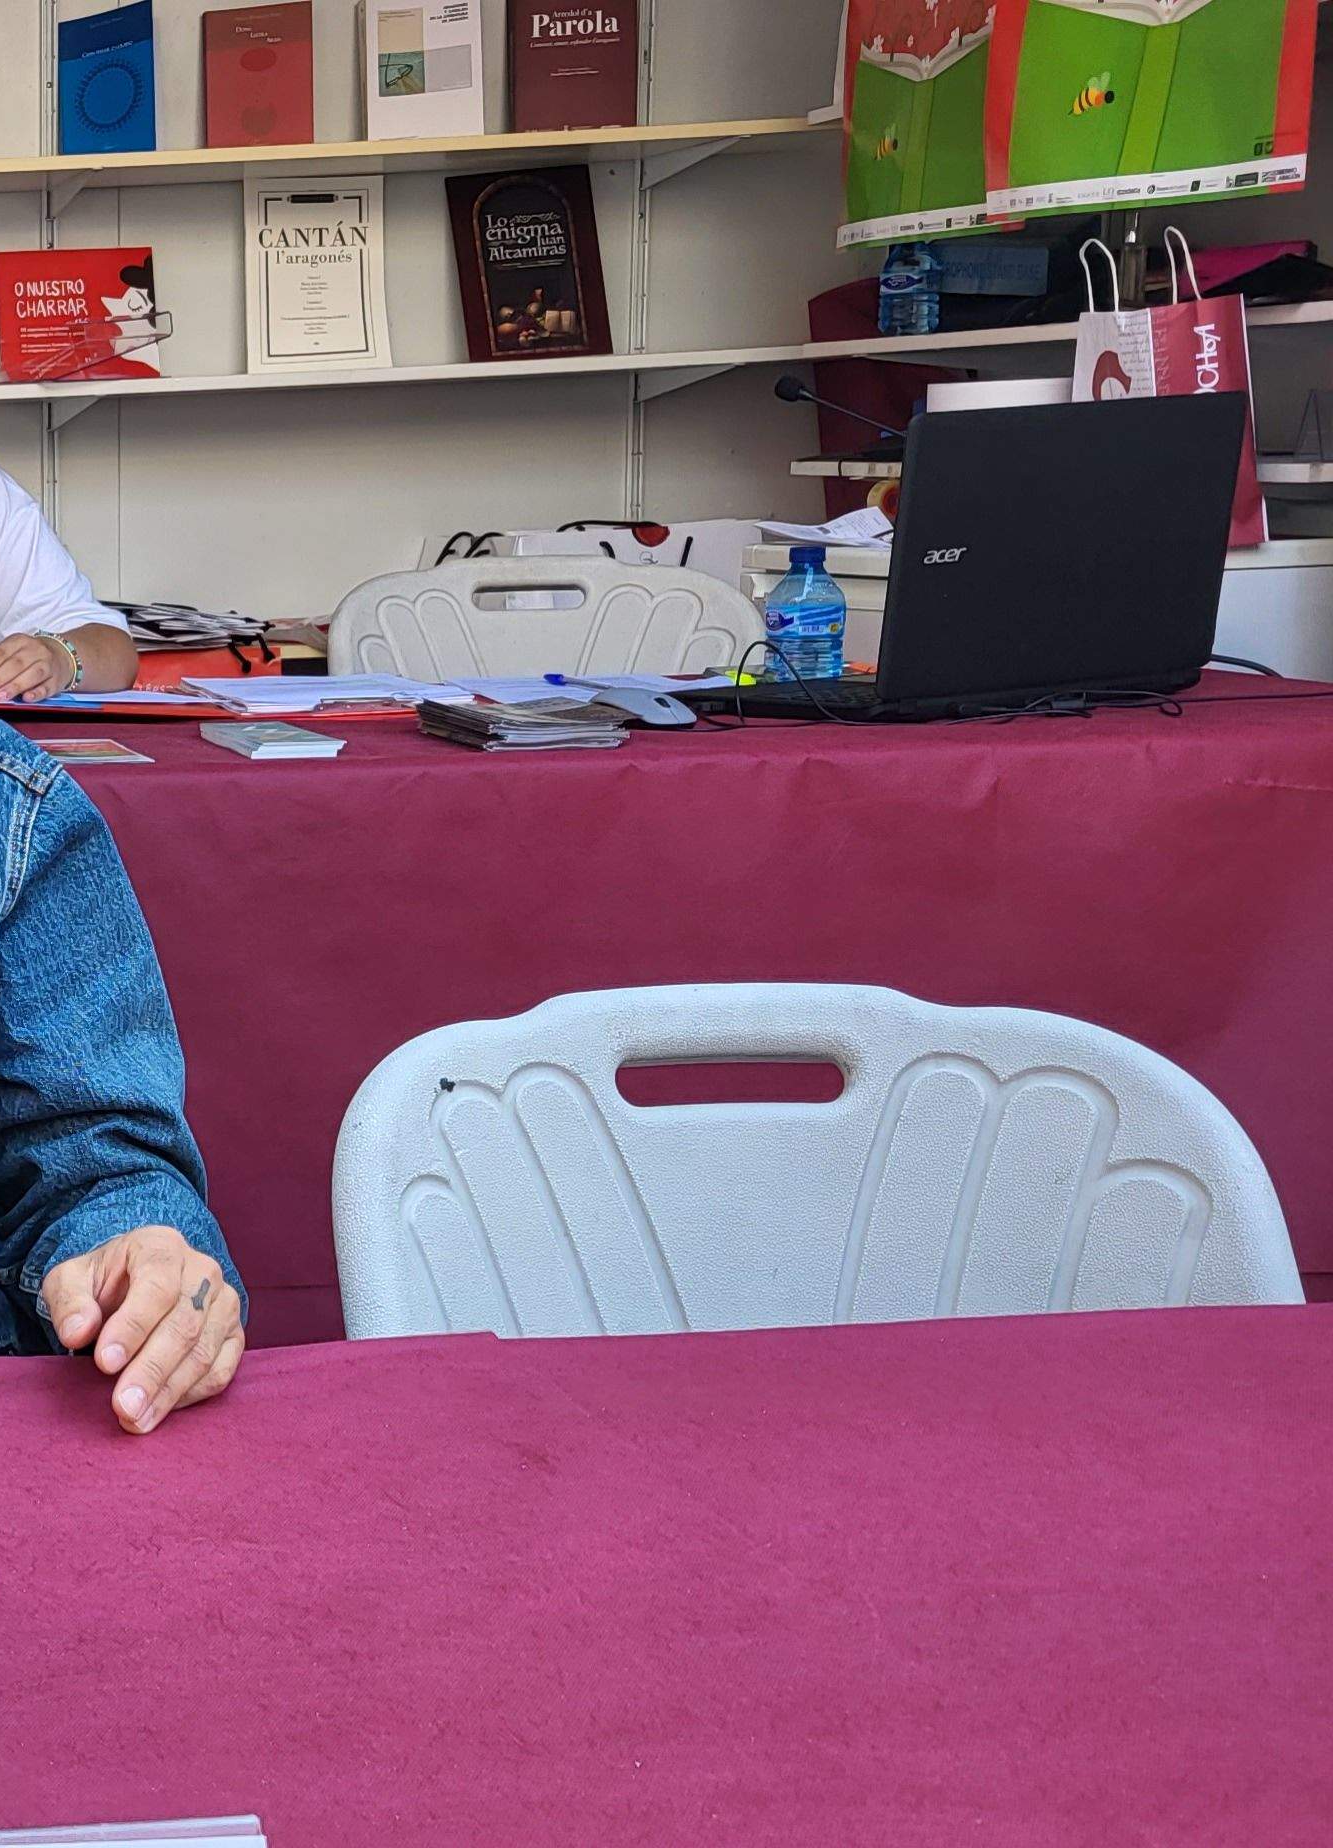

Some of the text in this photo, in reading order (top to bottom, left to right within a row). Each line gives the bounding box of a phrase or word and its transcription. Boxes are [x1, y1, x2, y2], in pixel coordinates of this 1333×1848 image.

[531, 10, 620, 38] Parola
[258, 220, 368, 249] CANTÁN
[485, 222, 564, 244] enigma
[276, 249, 353, 268] l'aragonés
[488, 244, 566, 261] Altamiras
[14, 278, 85, 297] O NUESTRO
[16, 298, 89, 319] CHARRAR
[923, 547, 967, 564] acer
